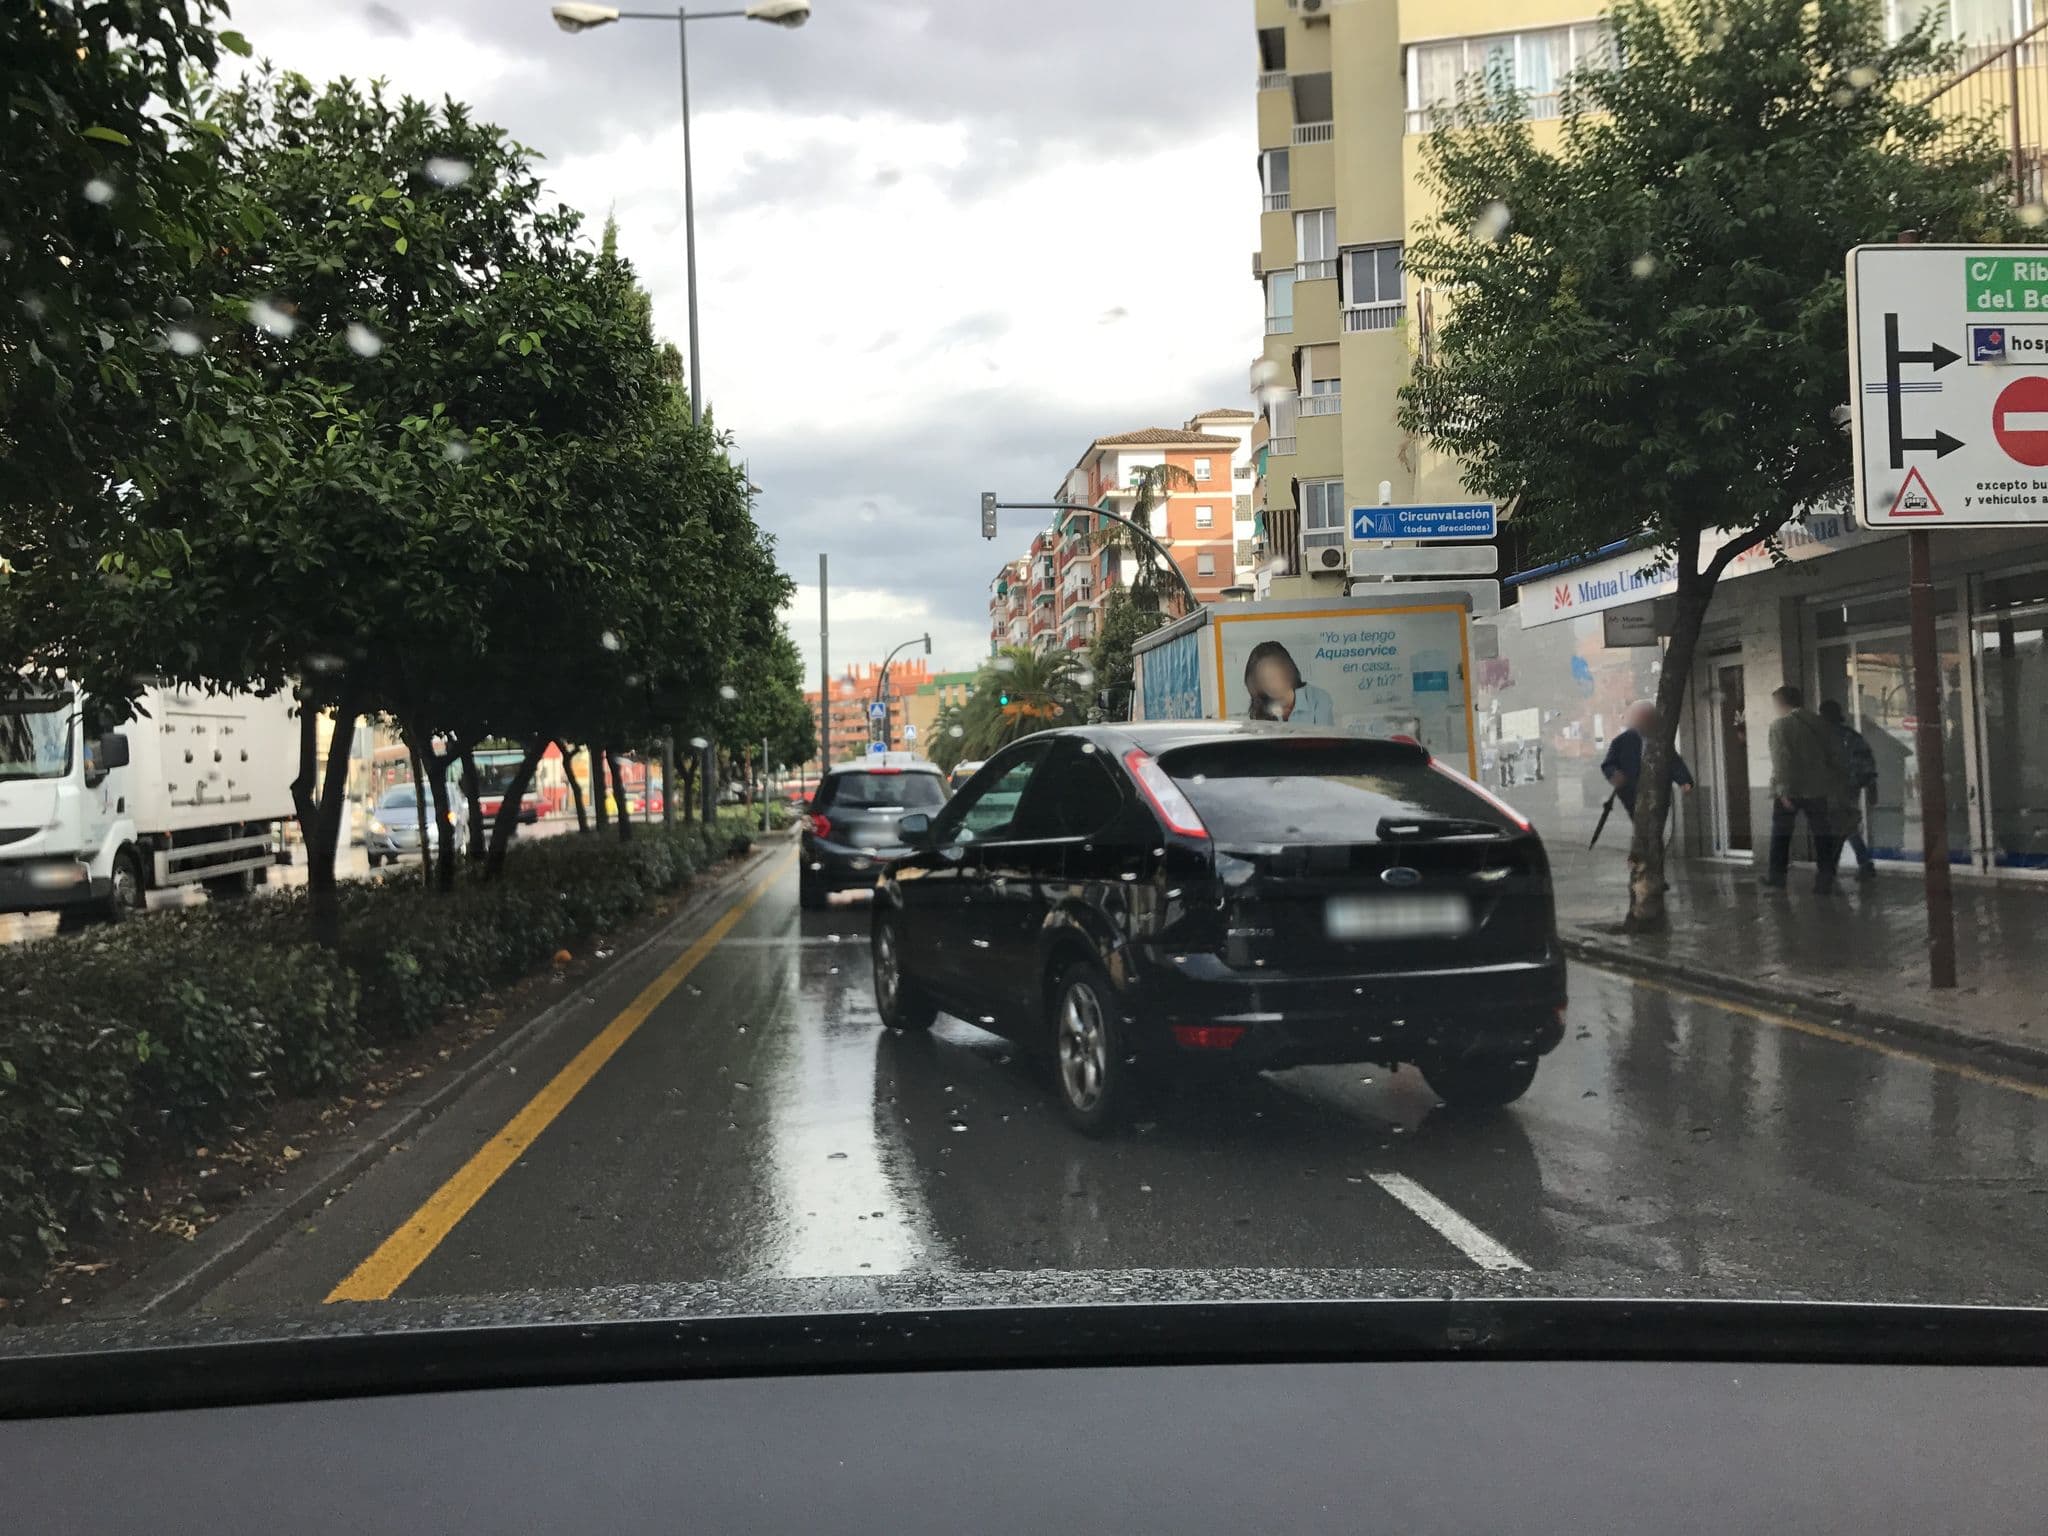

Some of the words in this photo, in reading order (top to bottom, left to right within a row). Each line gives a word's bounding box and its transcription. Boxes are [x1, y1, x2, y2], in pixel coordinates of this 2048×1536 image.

[1971, 261, 1999, 281] C/
[1977, 289, 2014, 309] del
[1976, 479, 2028, 492] excepto
[1965, 496, 1972, 507] y
[1399, 509, 1490, 522] Circunvalación
[1403, 525, 1432, 533] (todas
[1437, 523, 1490, 533] direcciones)
[1578, 579, 1618, 604] Mutua
[1343, 632, 1357, 645] ya
[1361, 630, 1396, 644] tengo
[1315, 644, 1397, 660] Aquaservice
[1343, 663, 1358, 673] en
